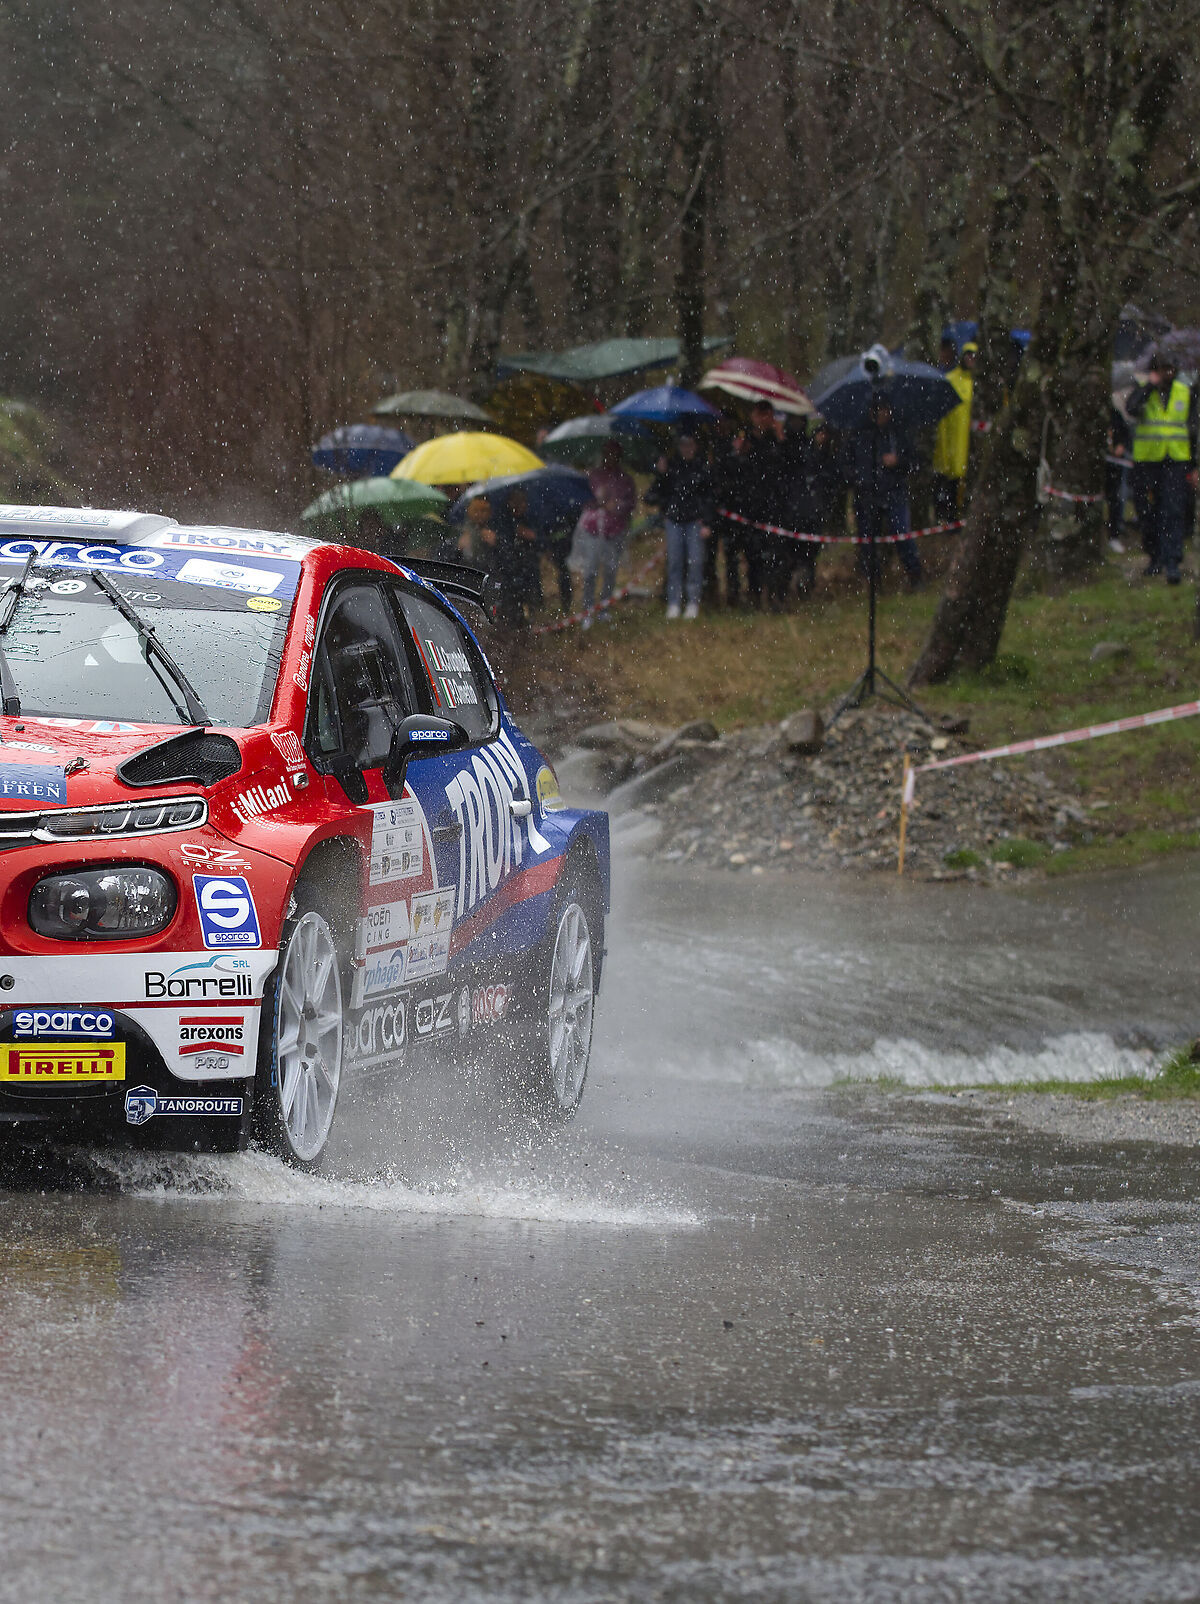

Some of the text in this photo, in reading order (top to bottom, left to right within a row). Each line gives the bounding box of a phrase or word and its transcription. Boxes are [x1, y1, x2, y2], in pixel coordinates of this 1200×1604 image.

[167, 532, 289, 553] TRONY
[183, 573, 268, 592] SPORT
[411, 730, 448, 740] sparco
[444, 727, 552, 919] TRONY
[182, 860, 252, 871] RACING
[215, 933, 250, 942] sparco
[232, 960, 251, 968] SRL
[145, 972, 252, 997] Borrelli
[15, 1012, 113, 1036] sparco
[180, 1027, 244, 1040] arexons
[8, 1049, 116, 1075] PIRELLI
[194, 1056, 230, 1070] PRO
